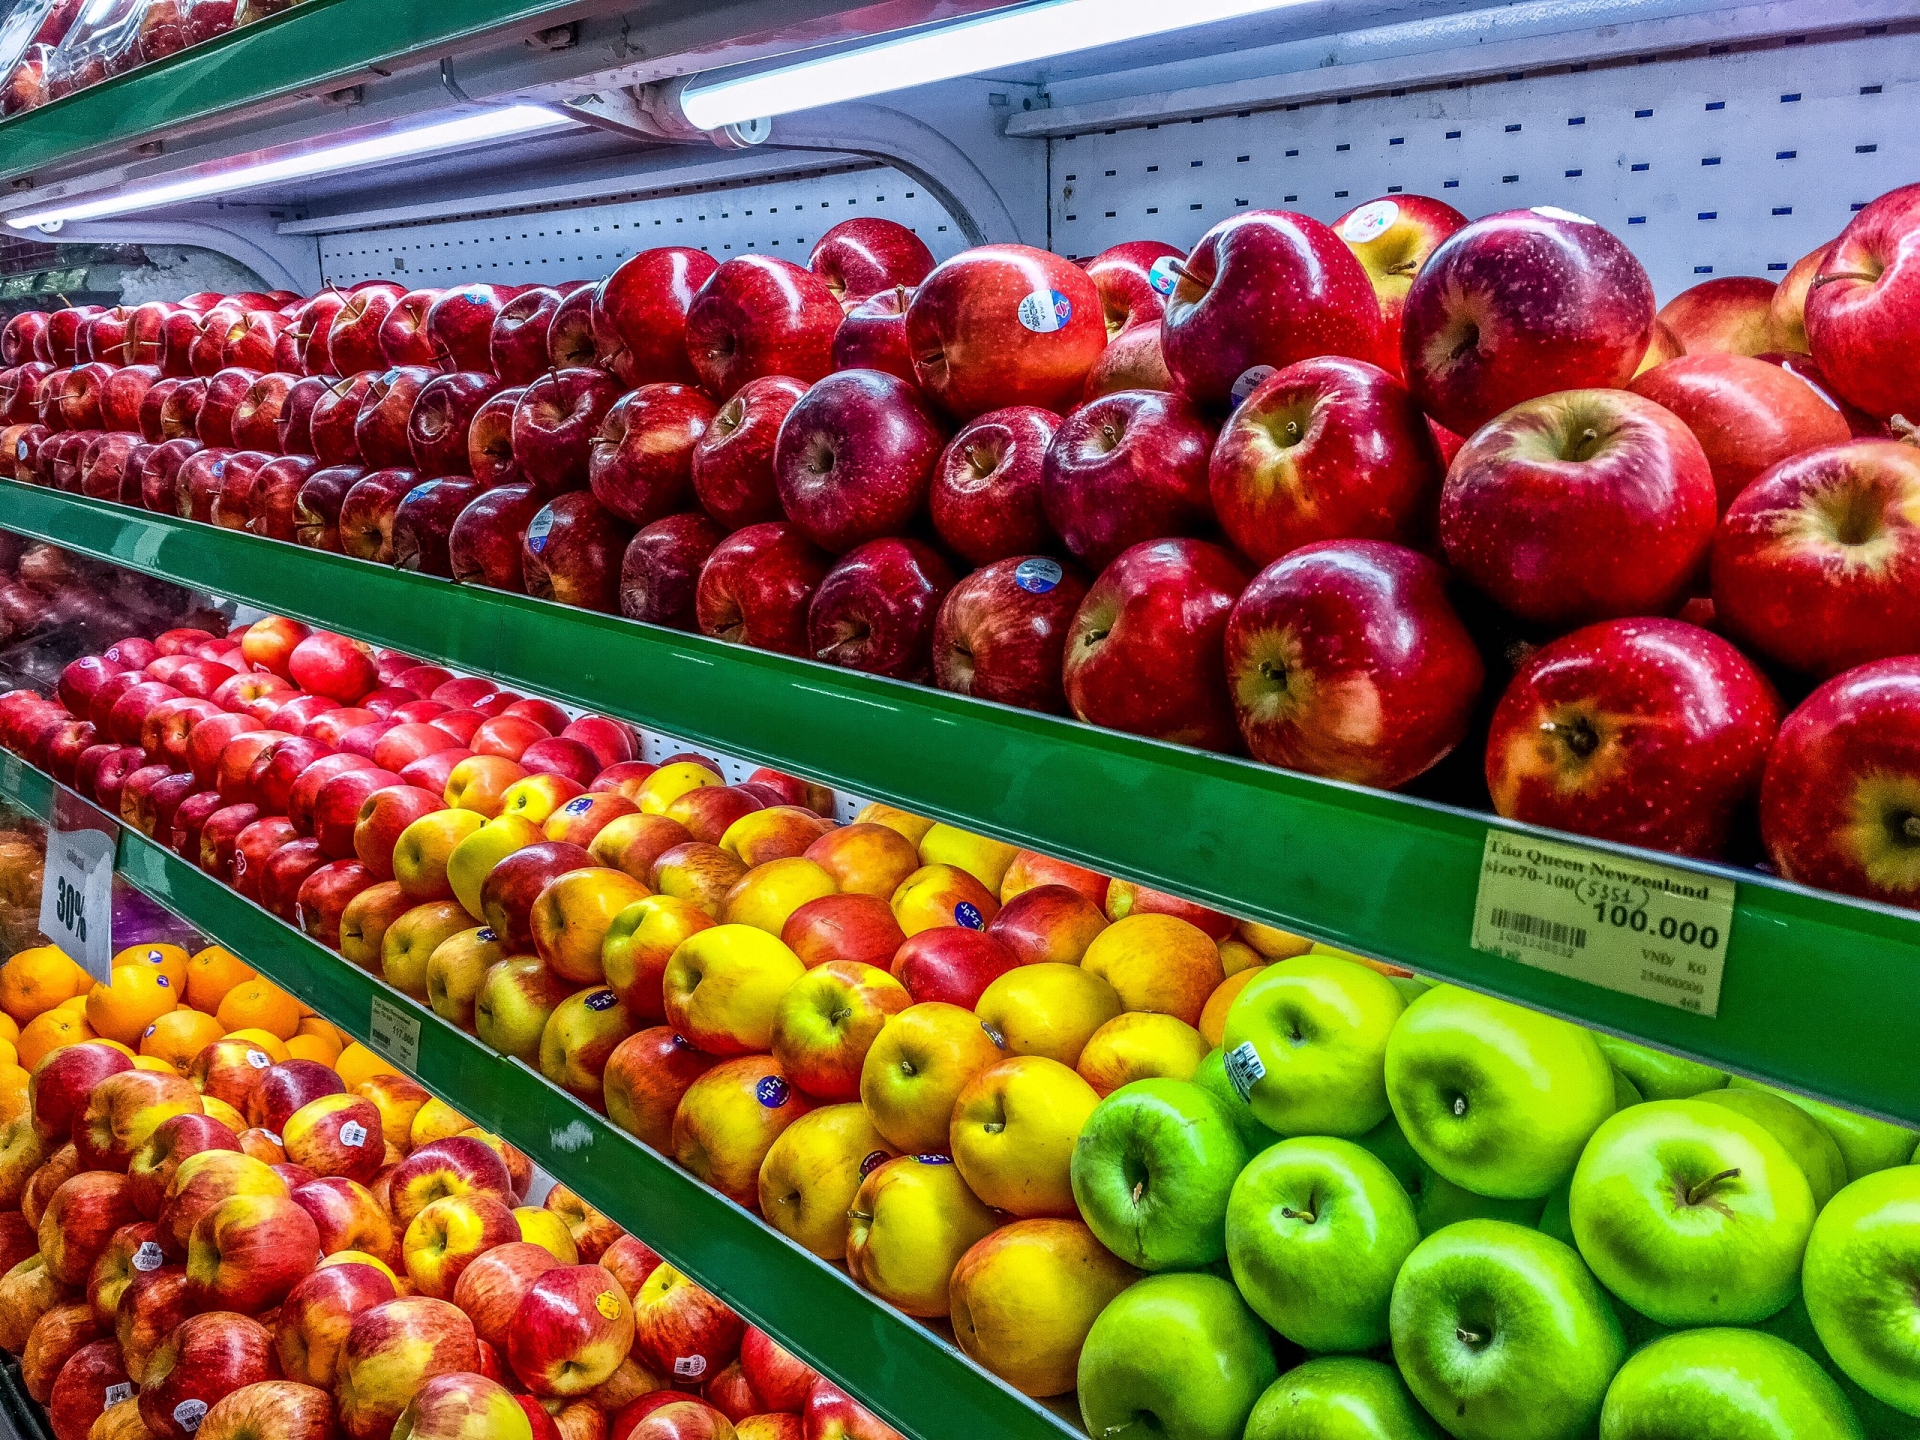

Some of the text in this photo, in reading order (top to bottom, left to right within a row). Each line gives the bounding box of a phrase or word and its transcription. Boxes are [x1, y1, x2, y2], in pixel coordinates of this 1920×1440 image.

[1527, 850, 1584, 872] Queen
[57, 876, 87, 943] 30%
[961, 903, 981, 926] JAZZ
[1594, 902, 1719, 950] 100.000
[760, 1079, 782, 1101] JAZZ
